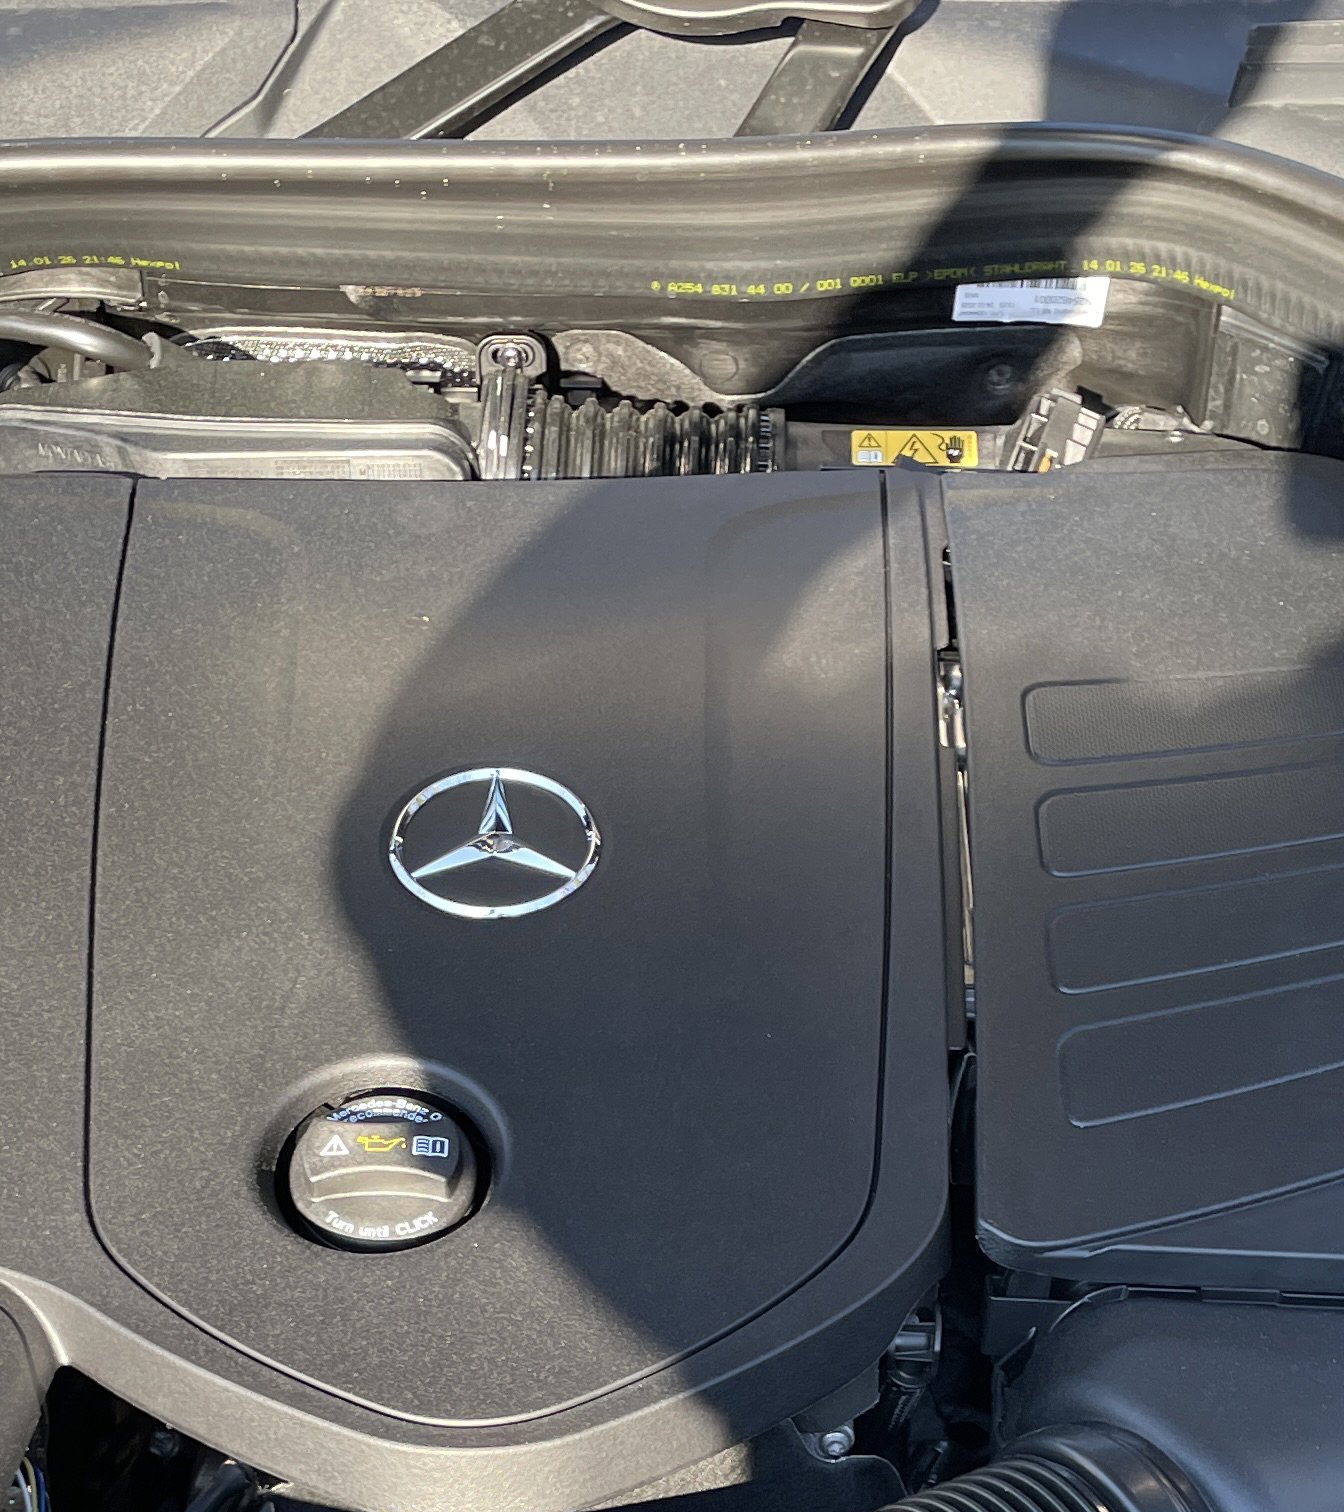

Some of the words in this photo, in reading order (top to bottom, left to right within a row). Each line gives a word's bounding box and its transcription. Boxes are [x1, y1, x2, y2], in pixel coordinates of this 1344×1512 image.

[666, 281, 704, 294] A254
[746, 283, 766, 295] 44
[815, 279, 842, 291] 001
[325, 1210, 355, 1234] Turn
[358, 1225, 390, 1238] until
[395, 1211, 439, 1236] CLICK
